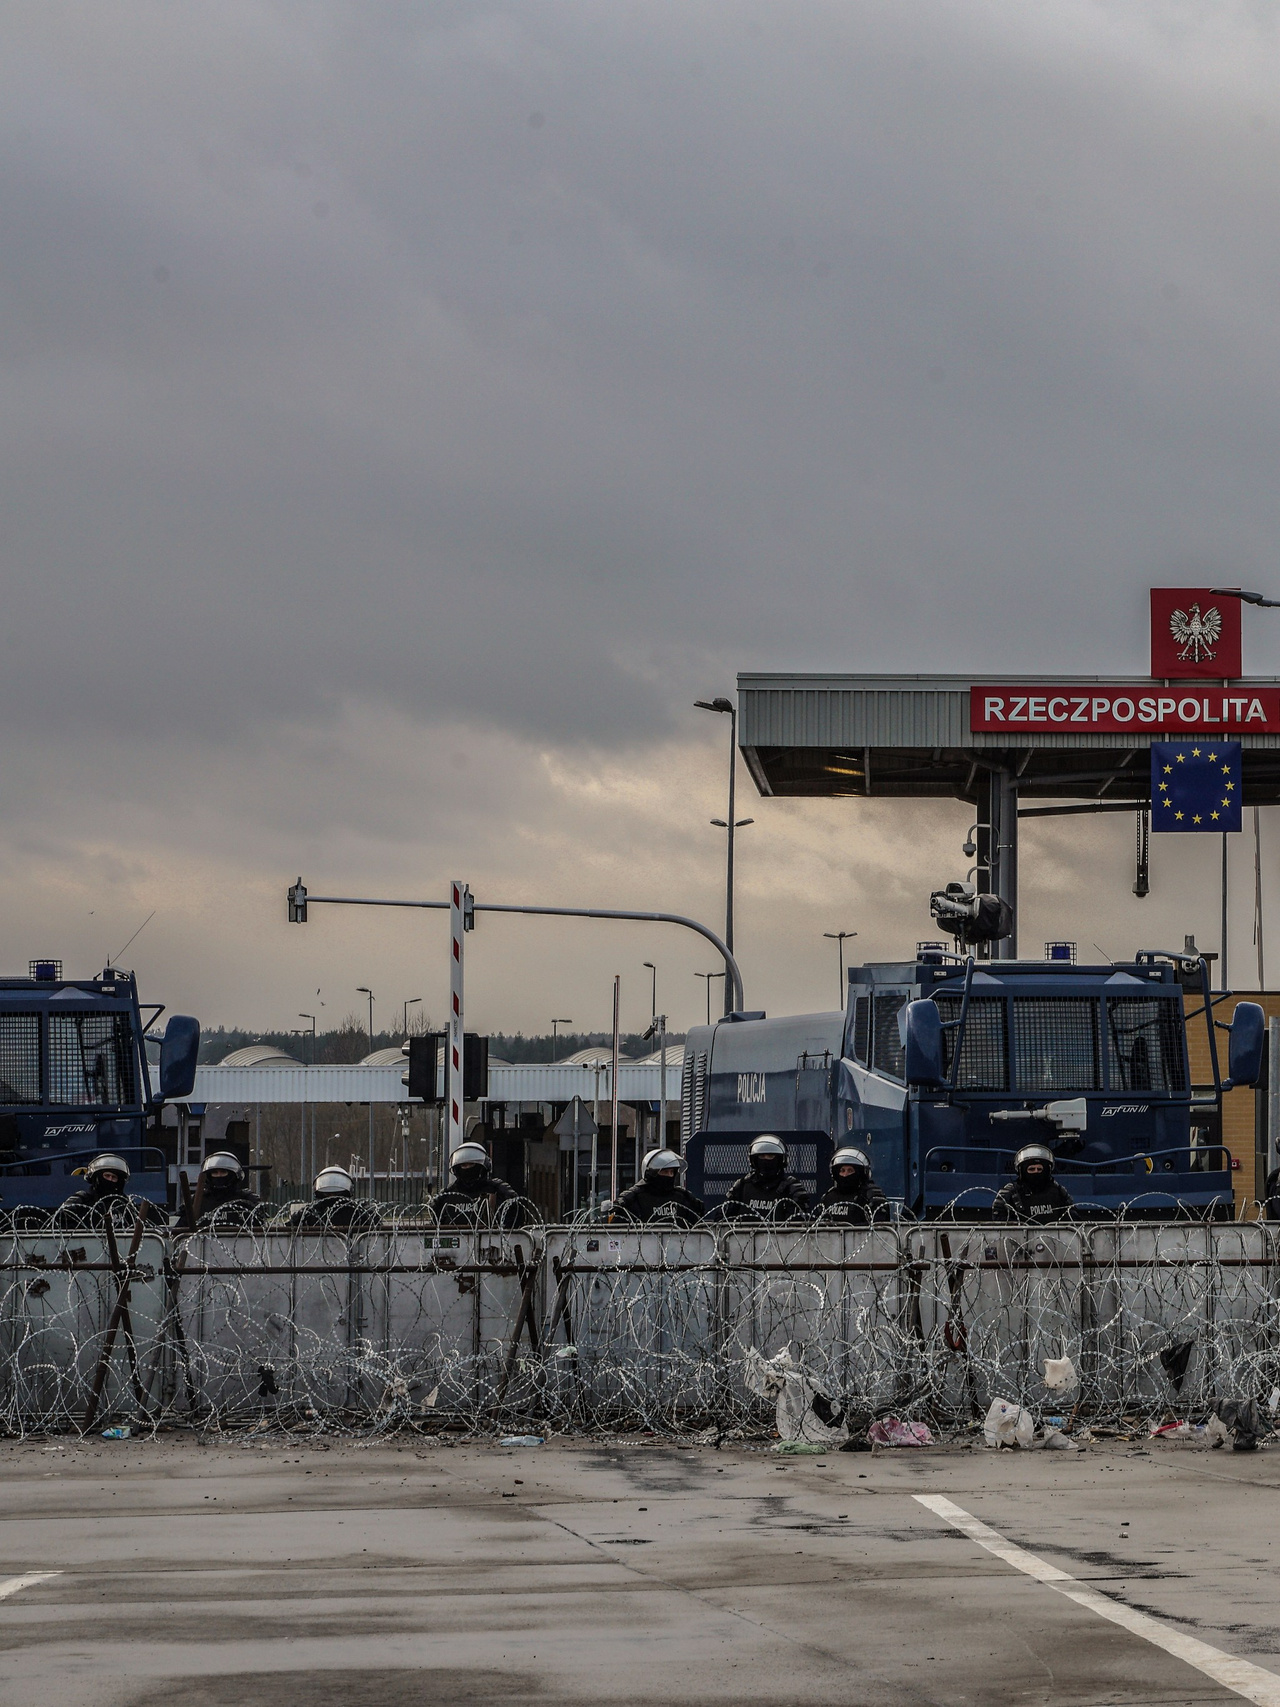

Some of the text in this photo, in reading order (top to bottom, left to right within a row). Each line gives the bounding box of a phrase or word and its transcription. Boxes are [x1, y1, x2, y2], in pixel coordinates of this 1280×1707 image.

[983, 696, 1268, 723] RZECZPOSPOLITA
[737, 1072, 766, 1103] POLICJA
[749, 1199, 773, 1210] POLICJA
[1030, 1204, 1054, 1215] POLICJA
